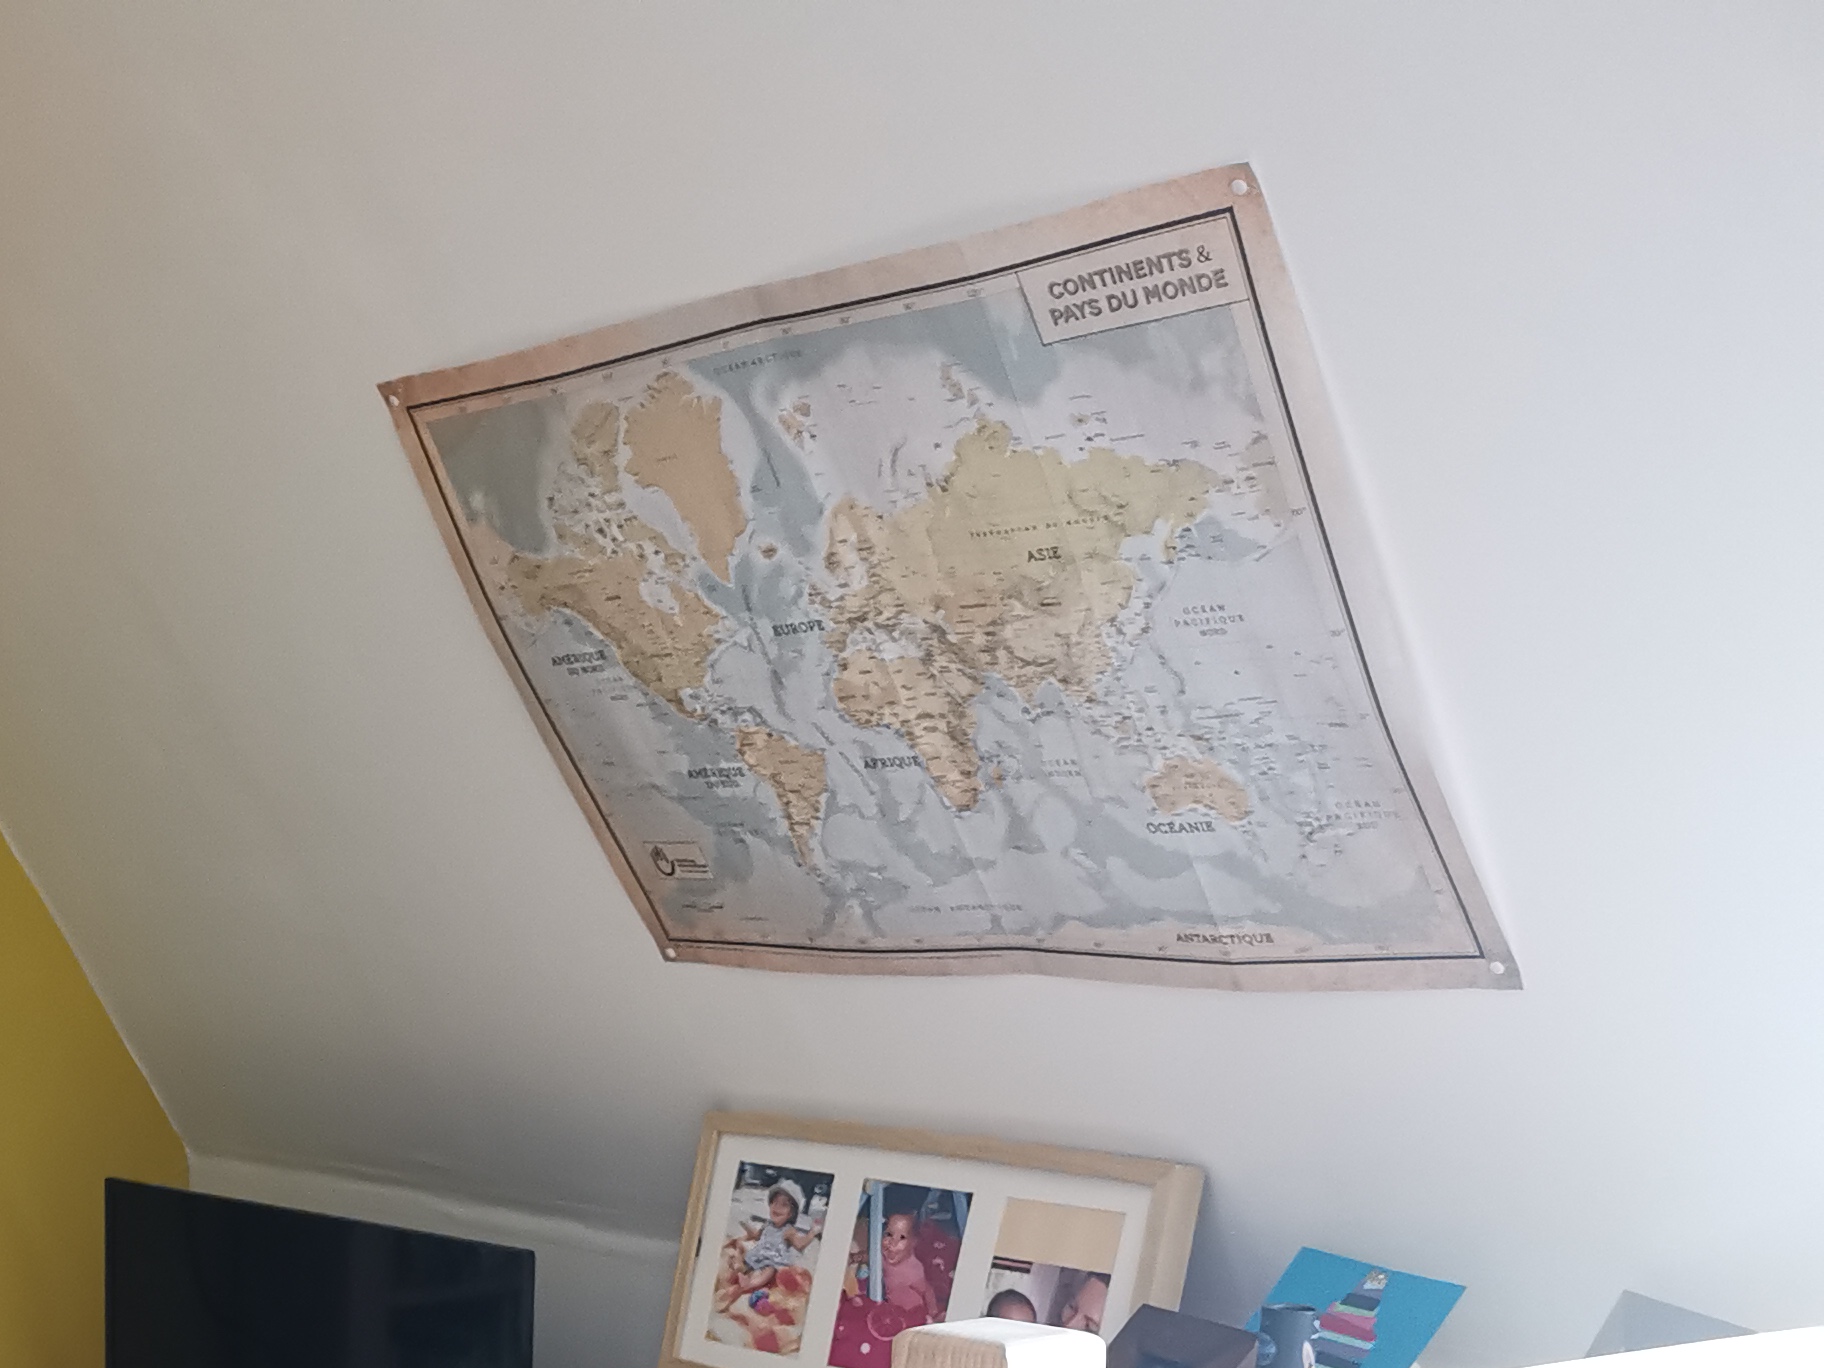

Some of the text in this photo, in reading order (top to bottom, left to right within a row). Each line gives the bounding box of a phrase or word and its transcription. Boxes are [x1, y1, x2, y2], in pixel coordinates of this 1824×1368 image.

[1047, 244, 1213, 301] CONTINENTS &
[1049, 267, 1230, 328] PAYS DU MONDE
[1027, 546, 1062, 563] ASIE
[772, 618, 826, 638] EUROPE
[862, 755, 922, 771] AFRIQUE
[1176, 932, 1275, 946] ANTARCTIQUE
